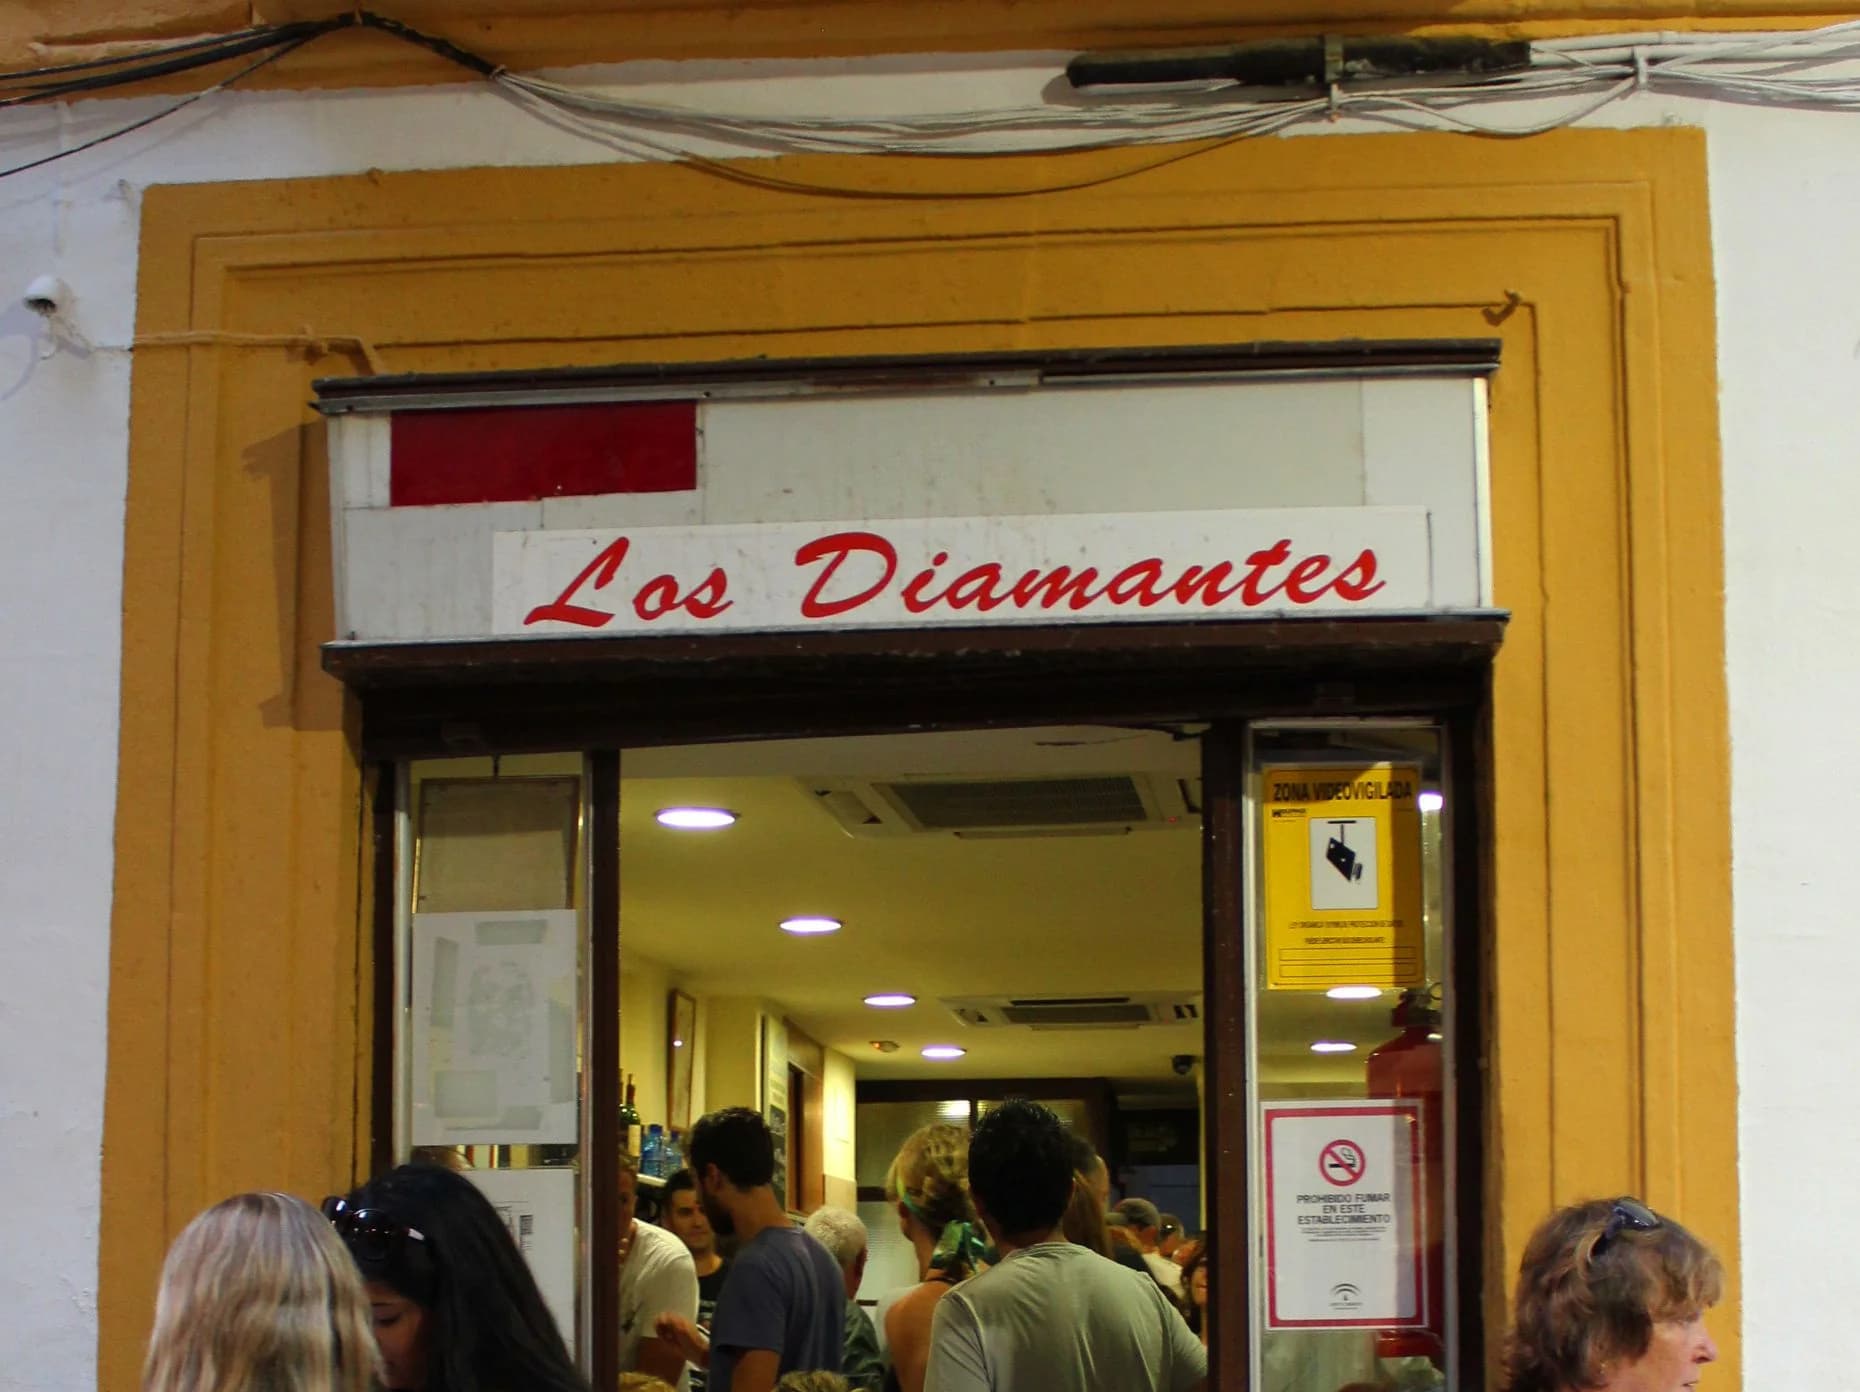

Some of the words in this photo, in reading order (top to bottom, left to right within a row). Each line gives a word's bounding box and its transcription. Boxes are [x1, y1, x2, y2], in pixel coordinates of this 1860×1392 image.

[523, 536, 731, 627] Los
[795, 531, 1387, 619] Diamantes
[1273, 782, 1309, 801] ZONA
[1313, 781, 1411, 801] VIDEOVIGILADA
[1297, 1194, 1353, 1204] PROHIBIDO
[1355, 1192, 1391, 1202] FUMAR
[1322, 1205, 1338, 1214] EN
[1340, 1204, 1366, 1213] ESTE
[1297, 1214, 1391, 1225] ESTABLECIMIENTO
